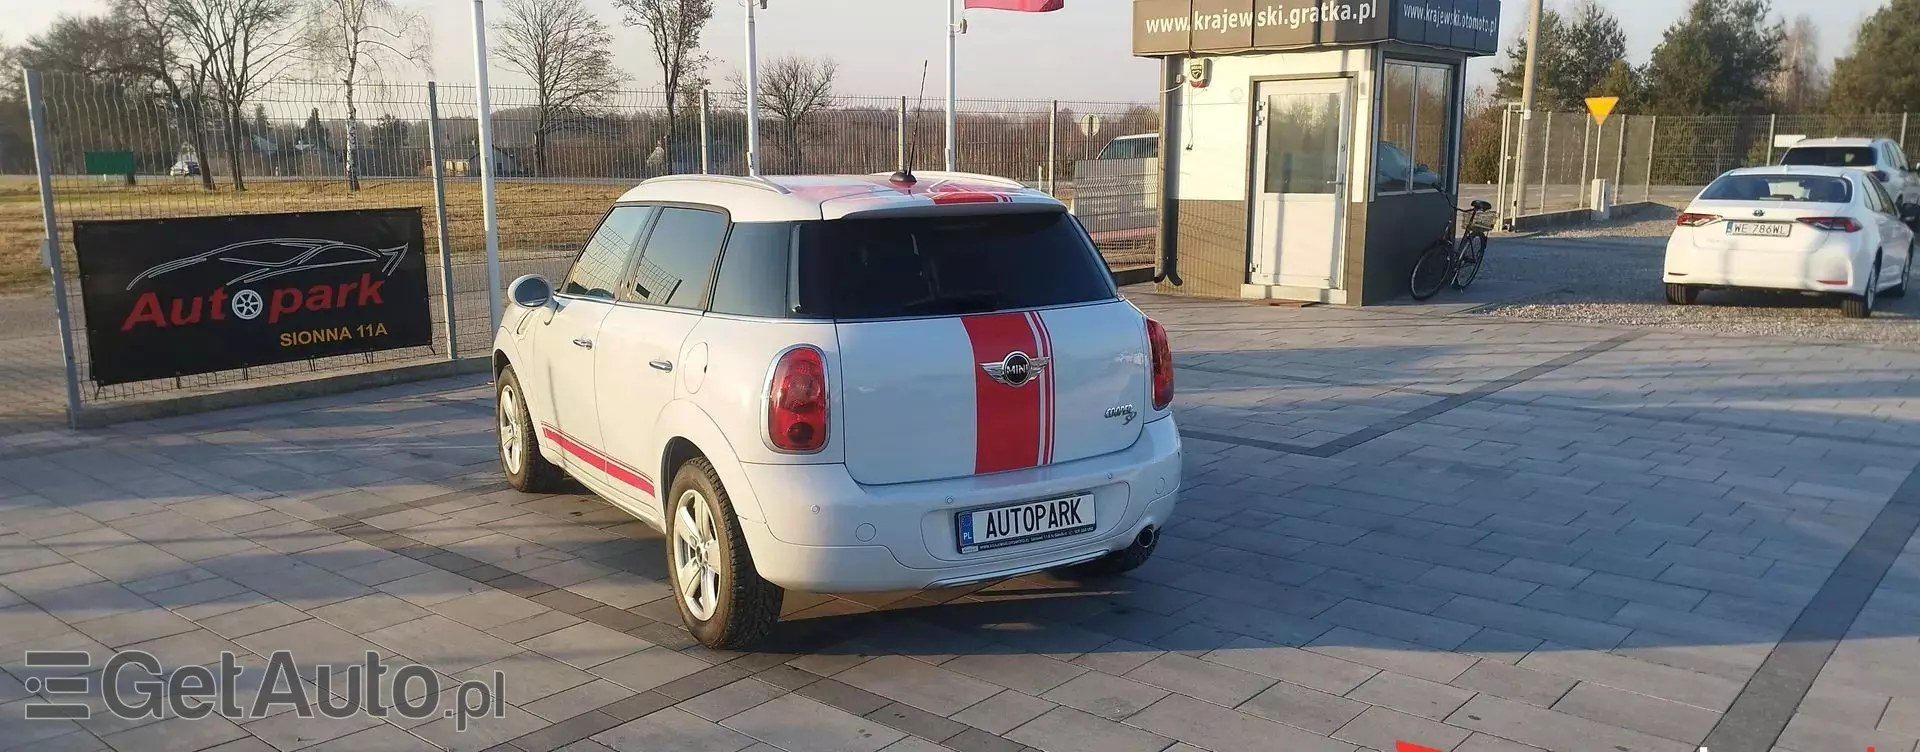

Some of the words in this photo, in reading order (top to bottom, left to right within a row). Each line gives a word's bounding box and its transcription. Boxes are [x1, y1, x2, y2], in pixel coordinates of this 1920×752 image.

[1735, 223, 1748, 233] WE
[1752, 224, 1786, 234] 786WL
[280, 326, 352, 347] SIONNA
[356, 322, 388, 339] 11A
[1006, 364, 1028, 375] MINI
[986, 498, 1082, 539] AUTOPARK
[963, 532, 973, 540] PL
